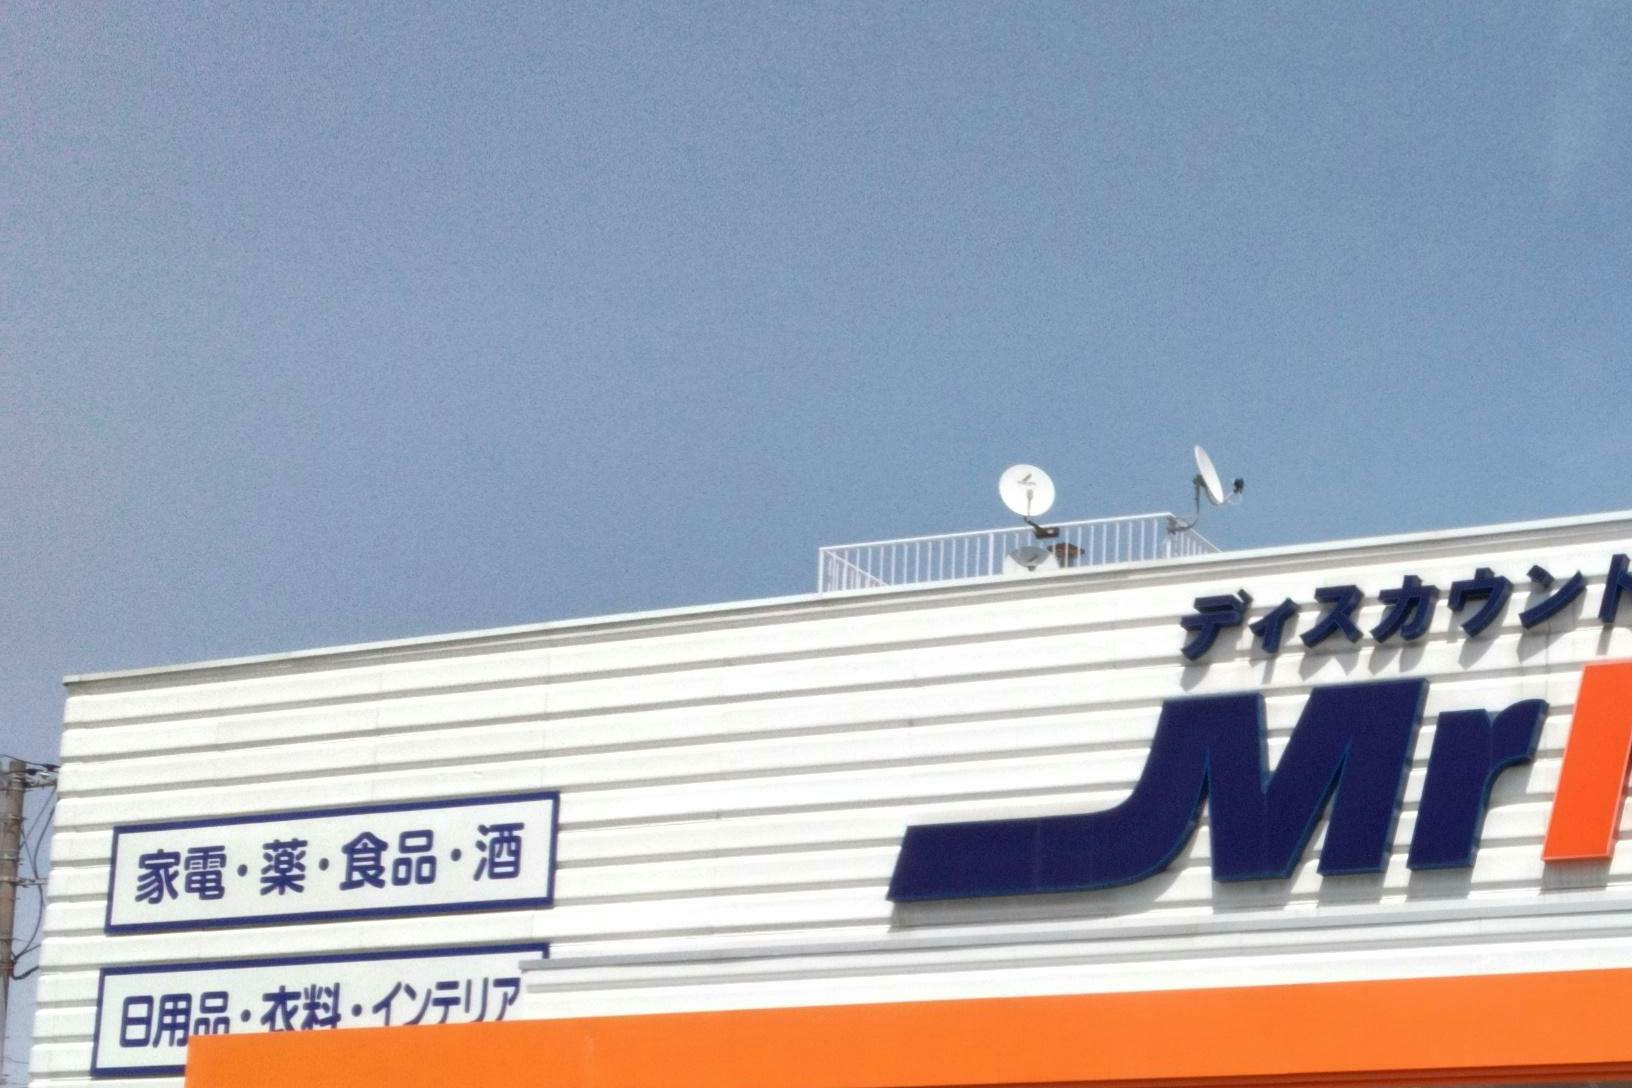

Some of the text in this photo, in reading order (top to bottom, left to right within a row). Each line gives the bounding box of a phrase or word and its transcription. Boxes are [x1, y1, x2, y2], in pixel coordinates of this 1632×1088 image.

[134, 822, 525, 905] 家電・薬・食品・酒
